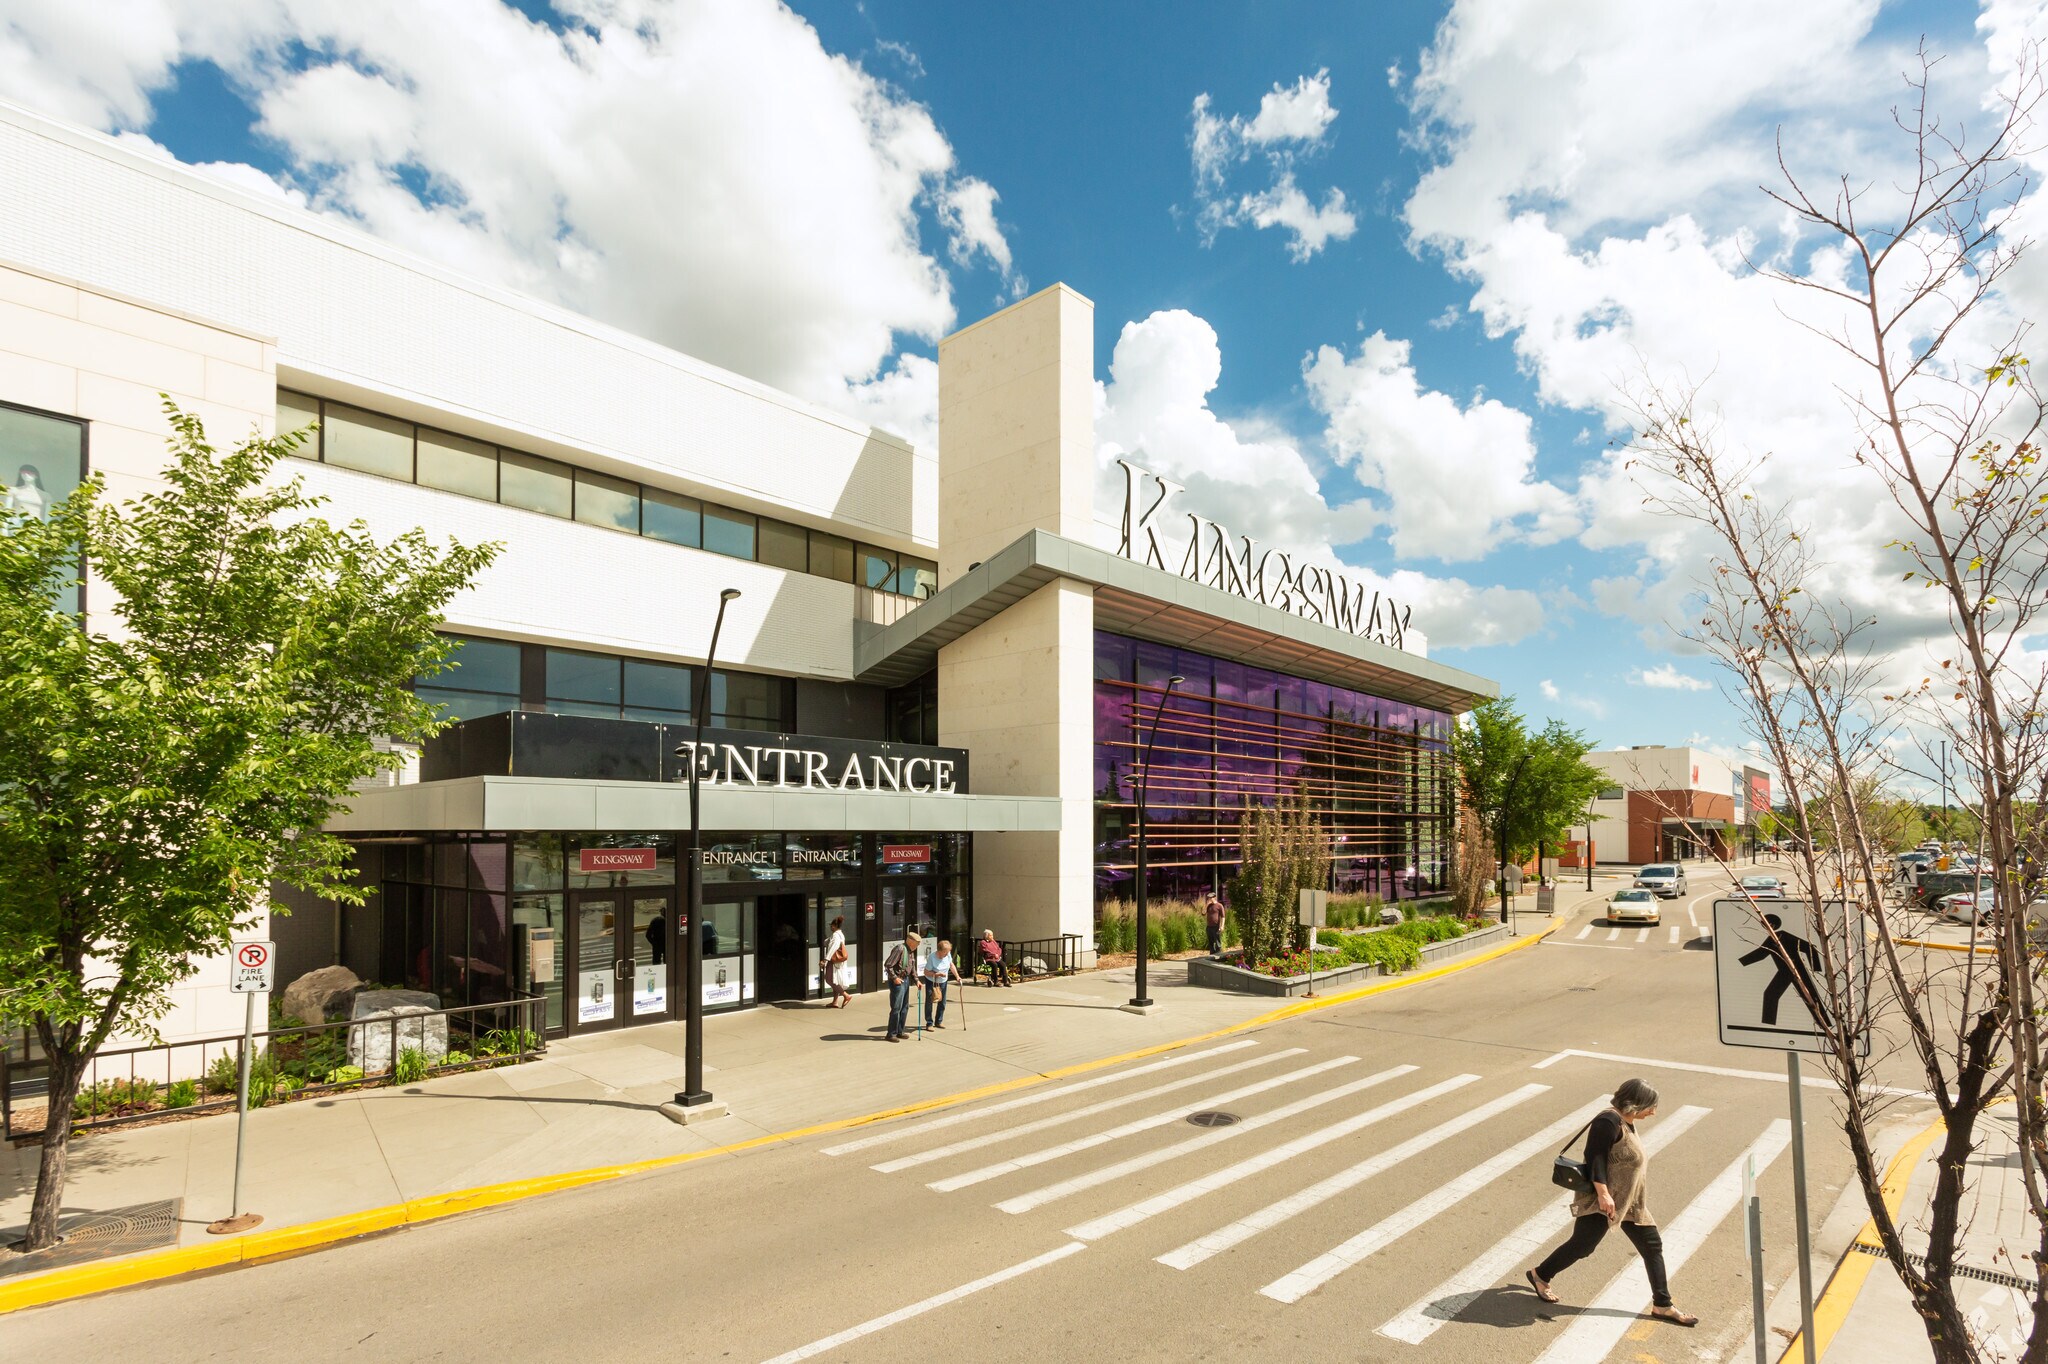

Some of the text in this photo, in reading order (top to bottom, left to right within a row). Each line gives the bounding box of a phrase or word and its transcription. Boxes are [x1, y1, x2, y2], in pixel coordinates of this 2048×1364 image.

[1117, 459, 1412, 650] KINGSWAY
[681, 741, 956, 794] ENTRANCE
[593, 854, 645, 865] KINGSWAY
[702, 851, 777, 865] ENTRANCE 1
[793, 850, 857, 863] ENTRANCE 1
[891, 850, 923, 858] KINGSWAY
